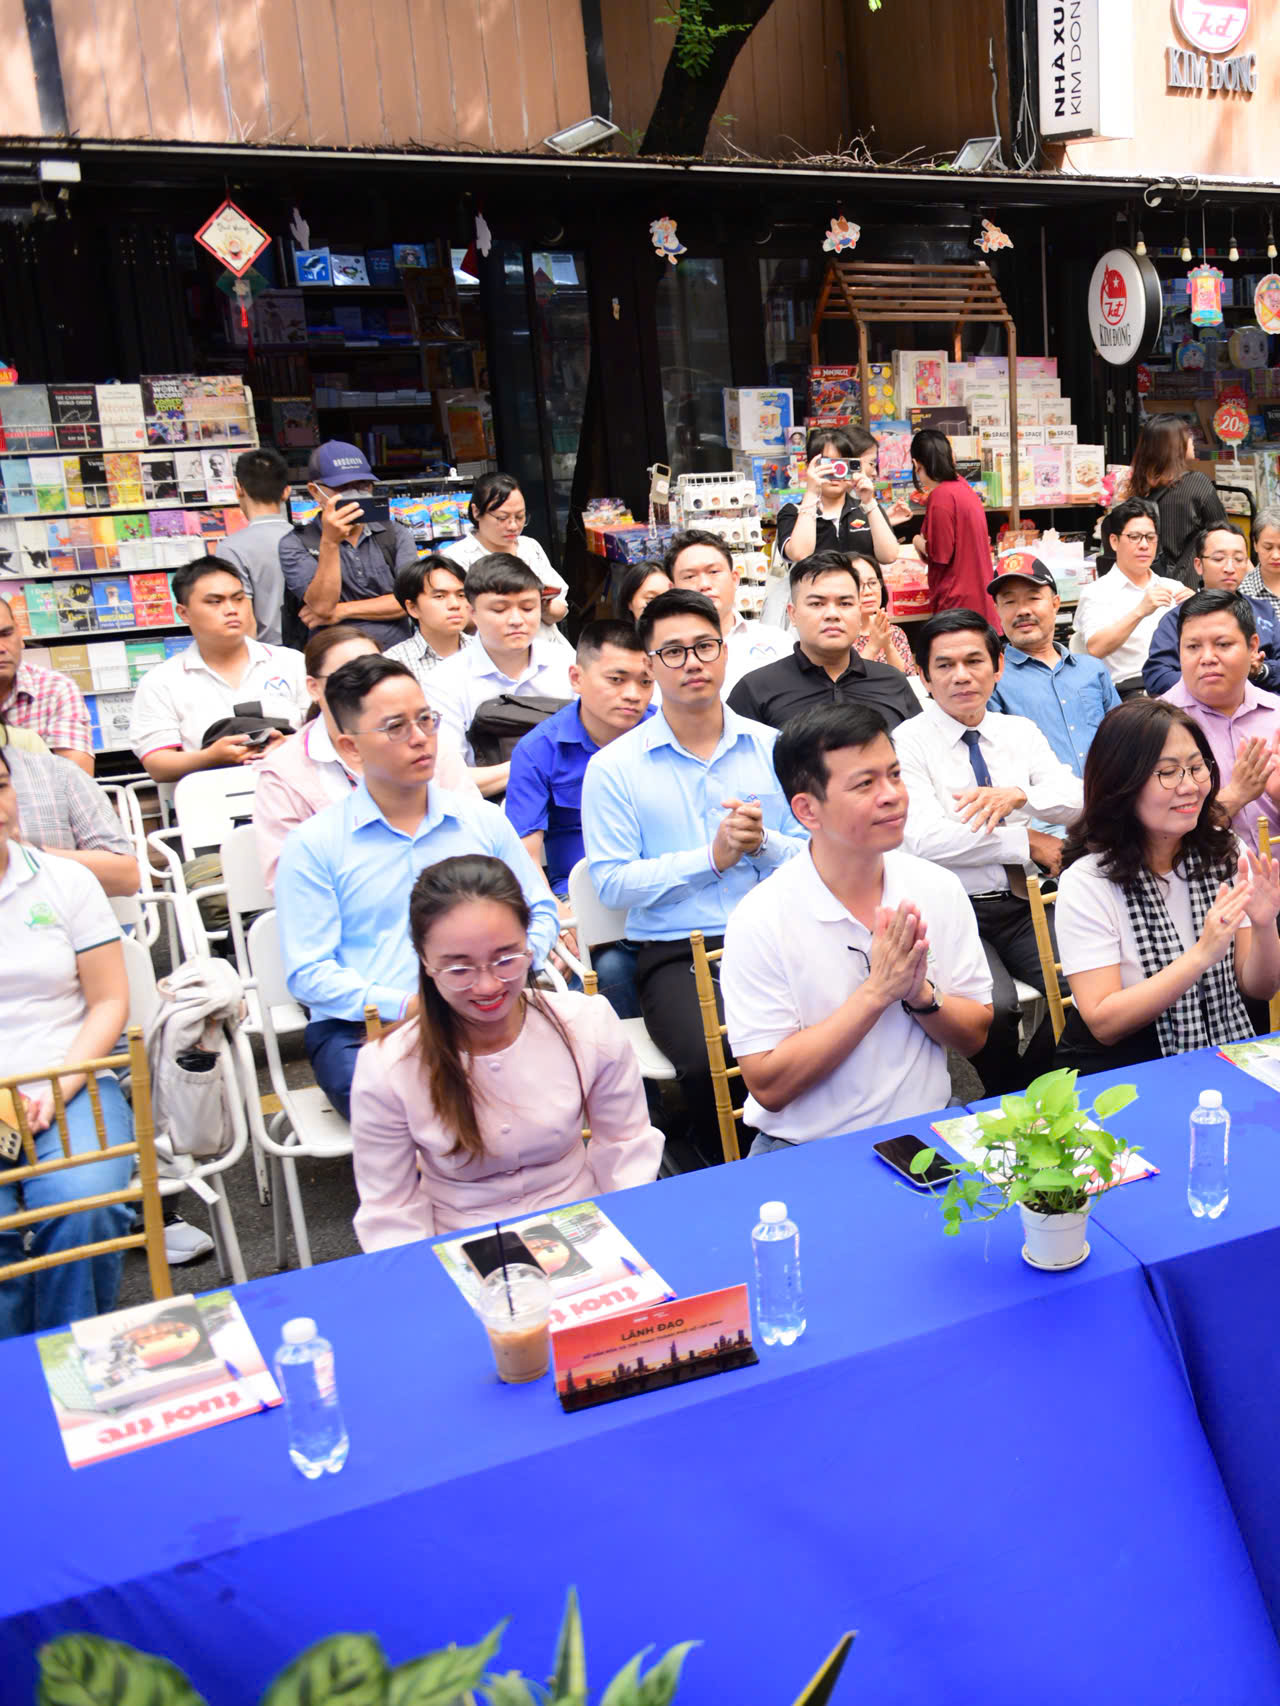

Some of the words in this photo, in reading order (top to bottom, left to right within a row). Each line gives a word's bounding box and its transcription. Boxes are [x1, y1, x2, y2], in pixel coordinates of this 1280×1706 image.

[1053, 0, 1065, 44] XU
[1052, 52, 1065, 117] NHÀ
[1168, 49, 1206, 89] KIM
[1070, 71, 1082, 115] KIM
